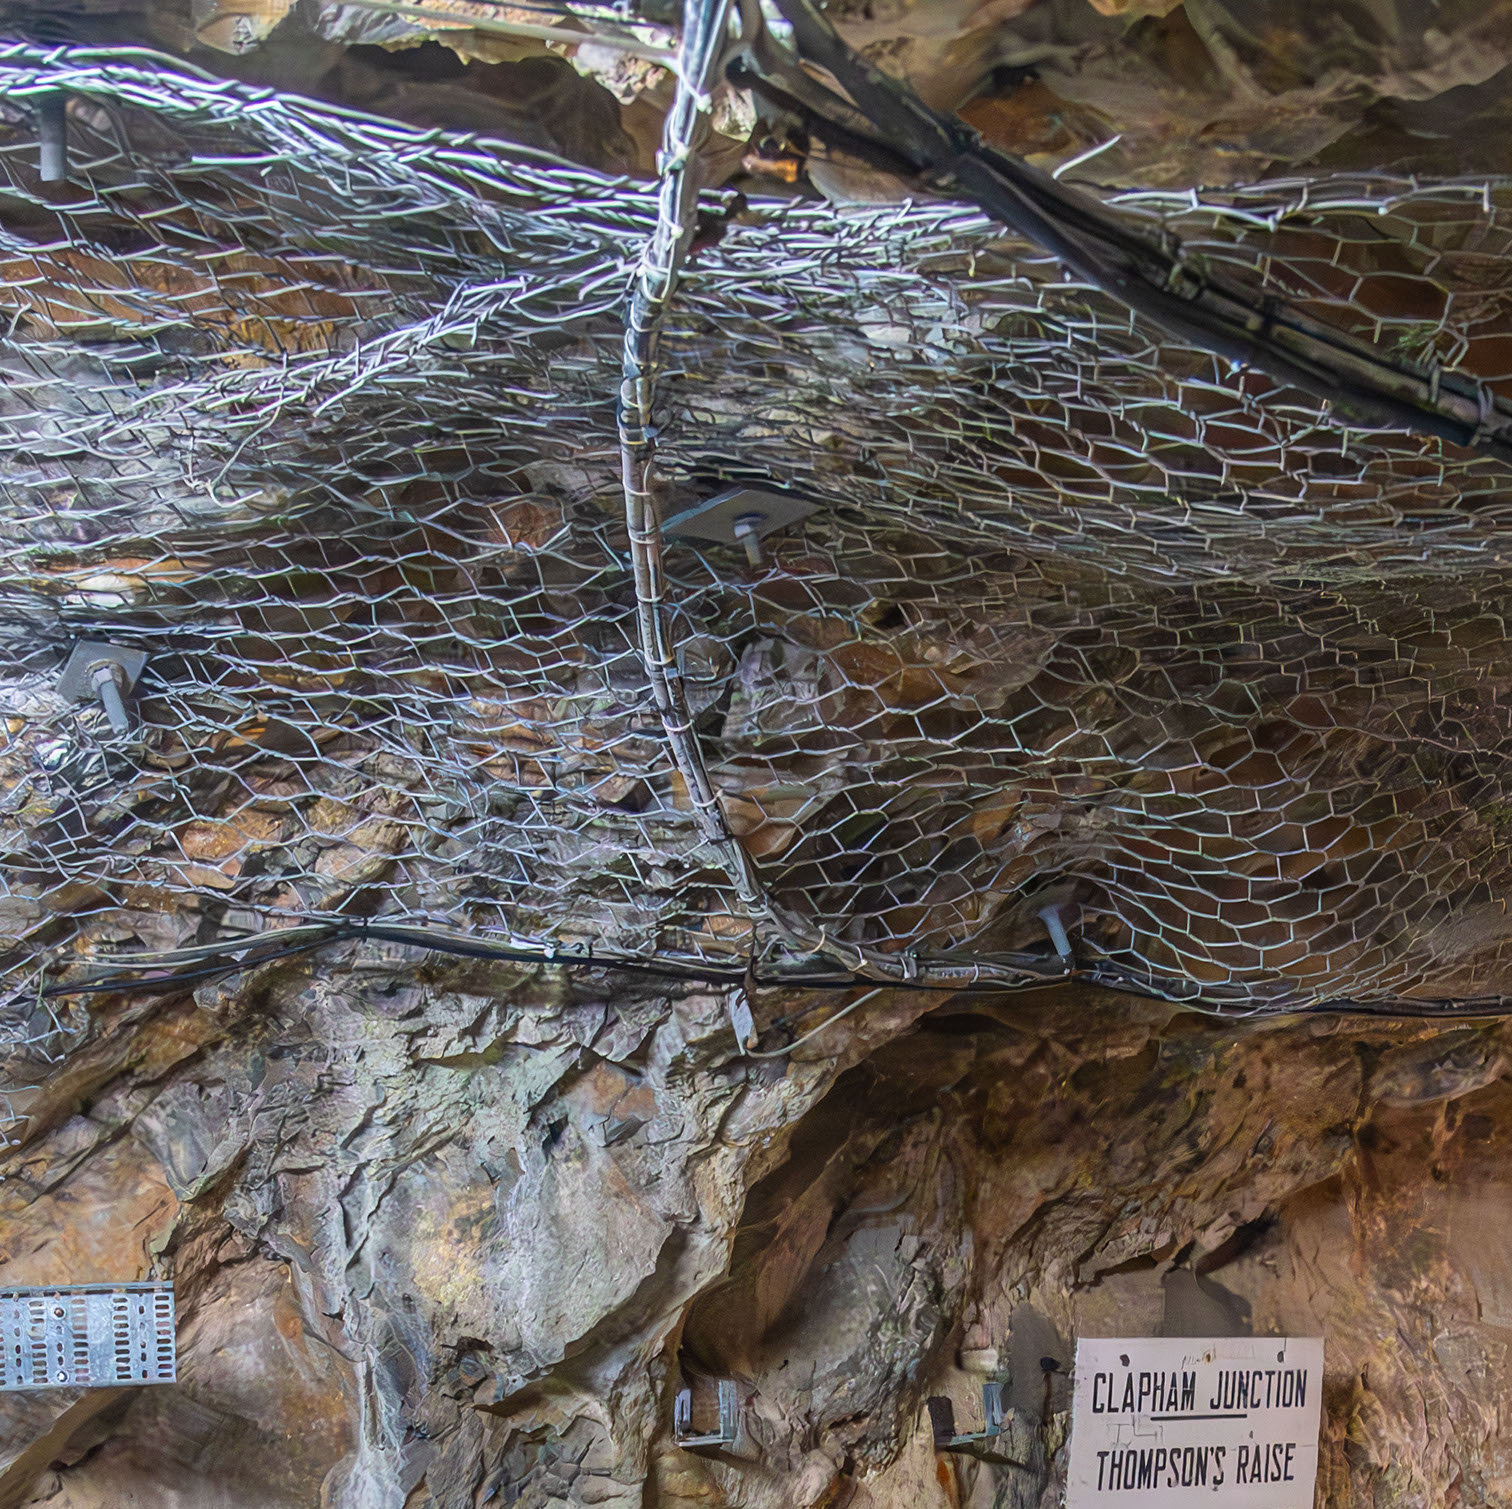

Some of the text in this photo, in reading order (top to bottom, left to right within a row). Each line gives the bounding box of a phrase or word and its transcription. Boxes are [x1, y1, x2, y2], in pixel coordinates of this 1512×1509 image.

[1092, 1369, 1307, 1413] CLAPHAM JUNCTION
[1097, 1443, 1296, 1491] THOMPSON'S RAISE
